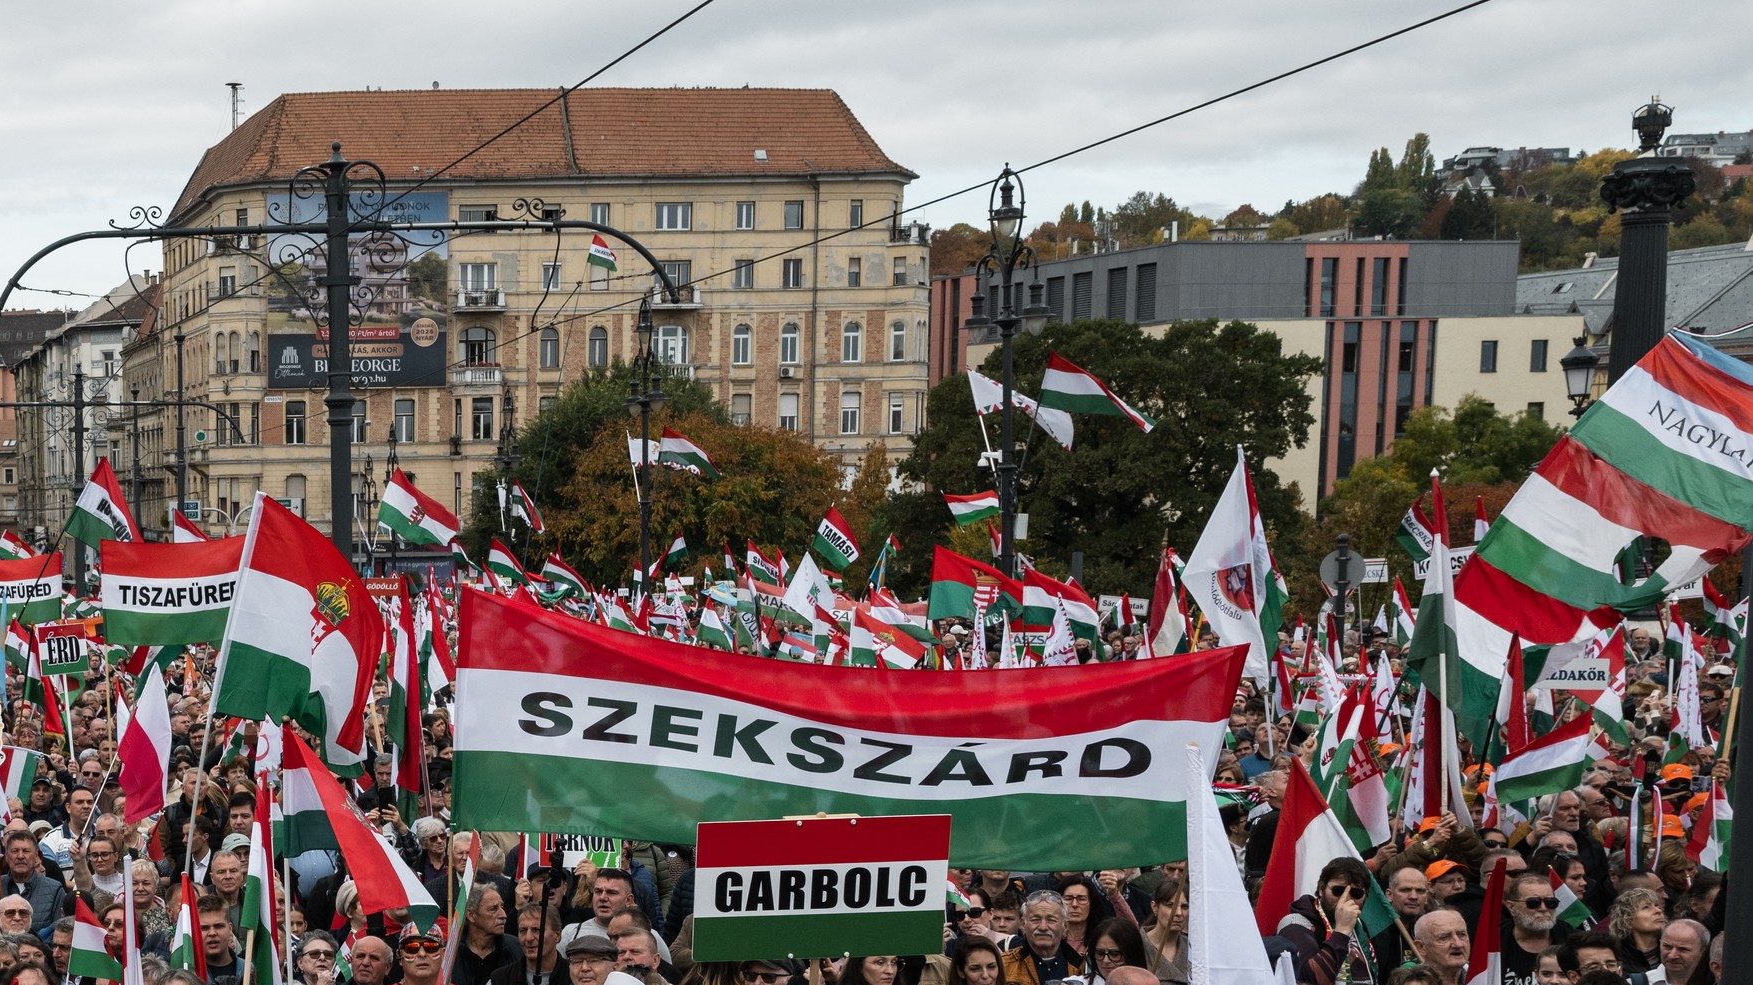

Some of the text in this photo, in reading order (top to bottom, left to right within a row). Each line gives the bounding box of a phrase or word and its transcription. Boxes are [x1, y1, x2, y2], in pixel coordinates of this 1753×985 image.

[315, 359, 401, 373] BIEORGE
[371, 346, 398, 354] AKKOR
[45, 632, 81, 667] ÉRD
[518, 690, 1152, 788] SZEKSZÁRD
[714, 864, 927, 913] GARBOLC
